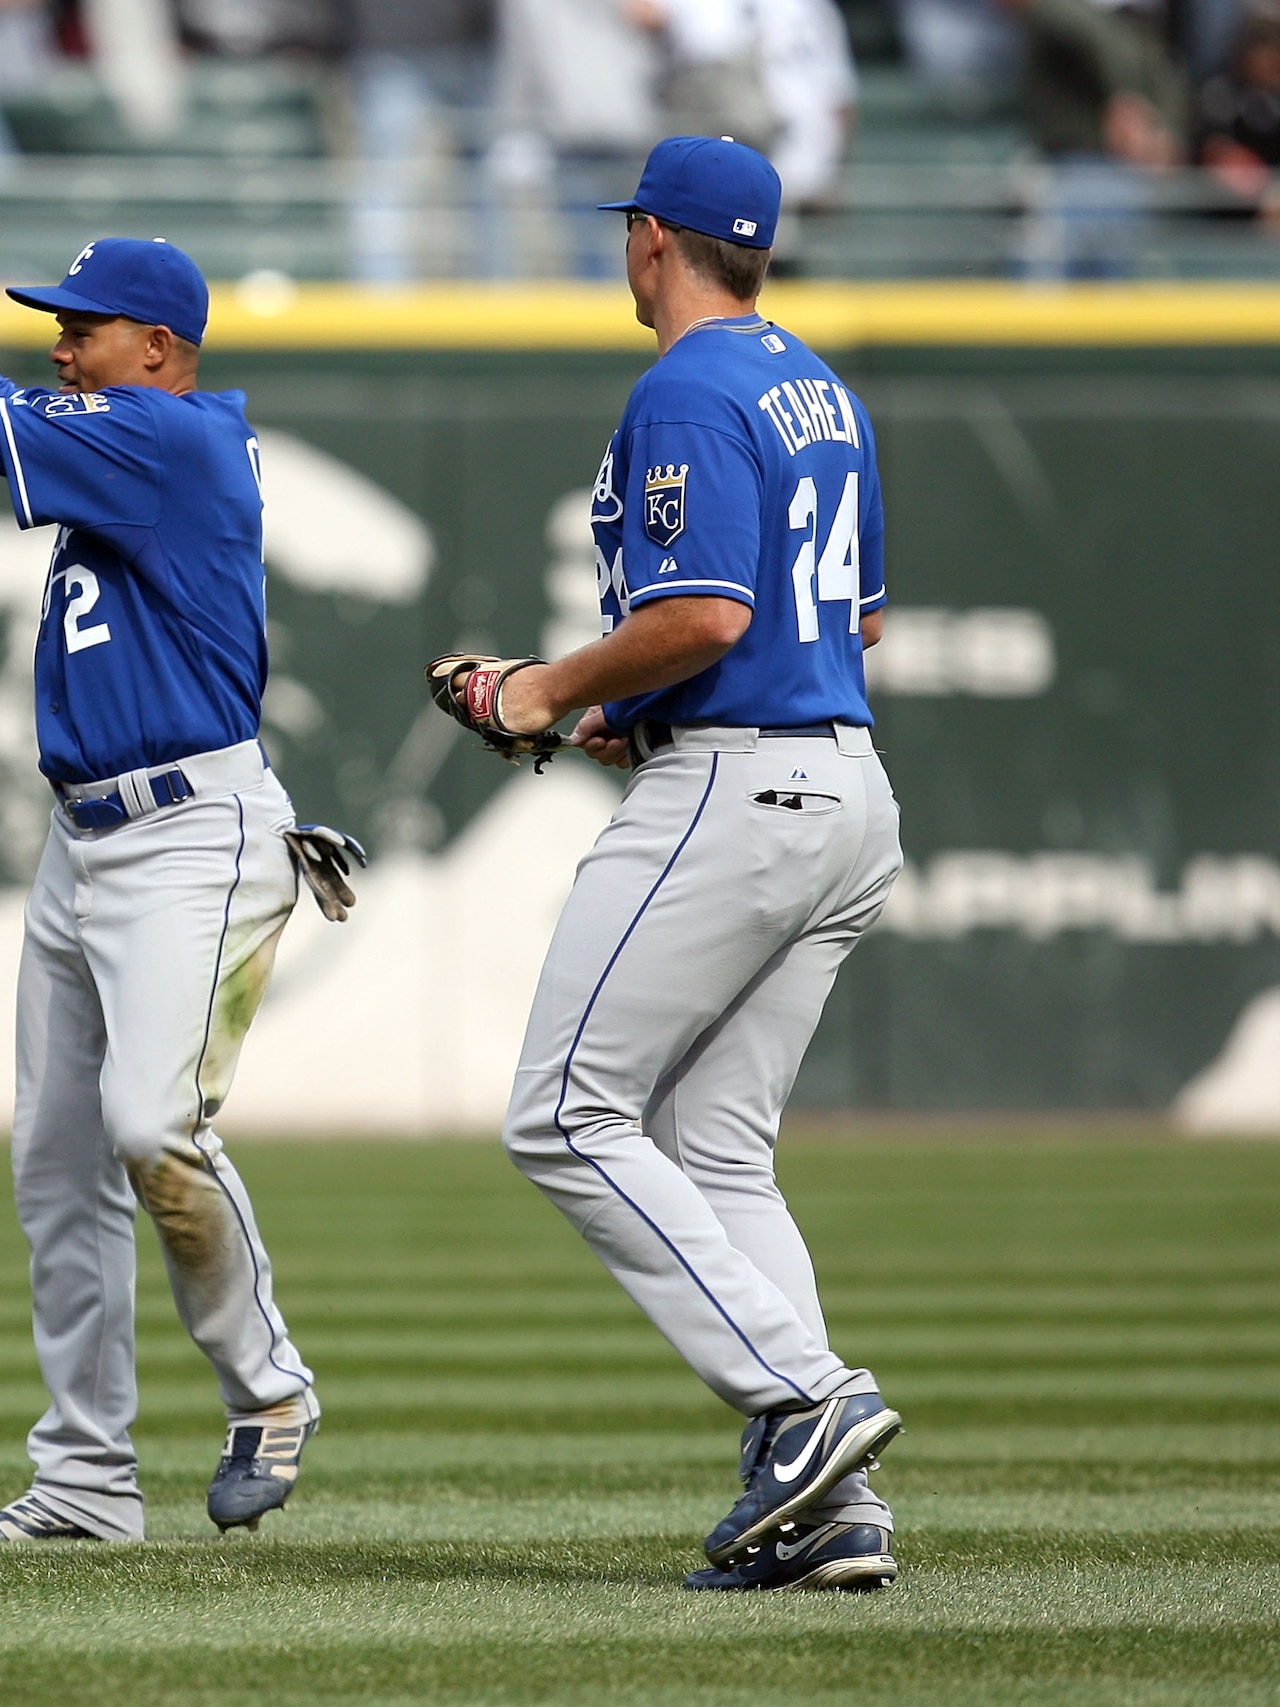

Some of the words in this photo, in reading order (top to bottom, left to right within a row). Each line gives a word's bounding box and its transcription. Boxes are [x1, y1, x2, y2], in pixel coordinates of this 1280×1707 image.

[758, 379, 860, 456] TEAHEN
[647, 493, 679, 530] KC
[787, 471, 861, 643] 24
[63, 562, 112, 655] 2
